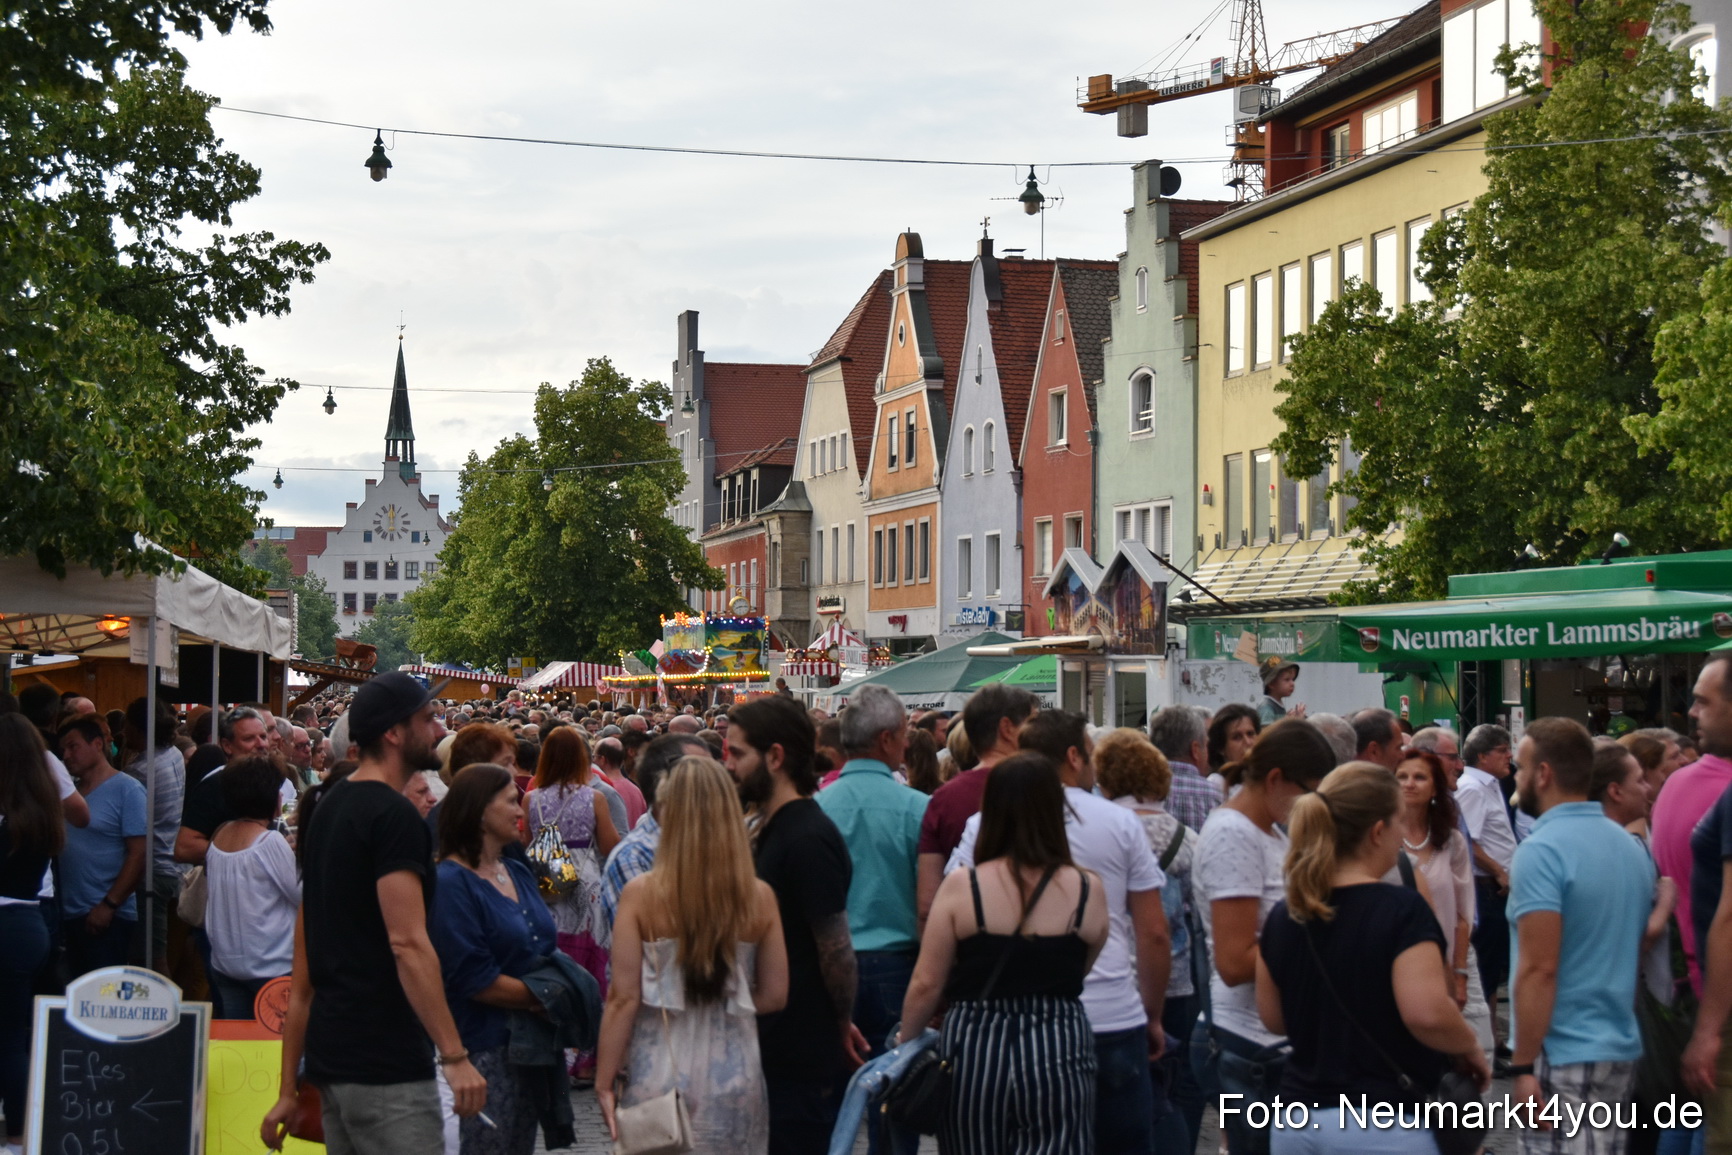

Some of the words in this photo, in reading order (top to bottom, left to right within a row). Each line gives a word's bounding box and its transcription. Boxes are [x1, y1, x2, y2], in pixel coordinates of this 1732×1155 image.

[1161, 81, 1204, 95] LIEBHERR
[1392, 623, 1539, 650] Neumarkter
[1546, 616, 1700, 645] Lammsbräu
[79, 1000, 168, 1021] KULMBACHER
[61, 1049, 125, 1091] Efes
[60, 1091, 115, 1121] Bier
